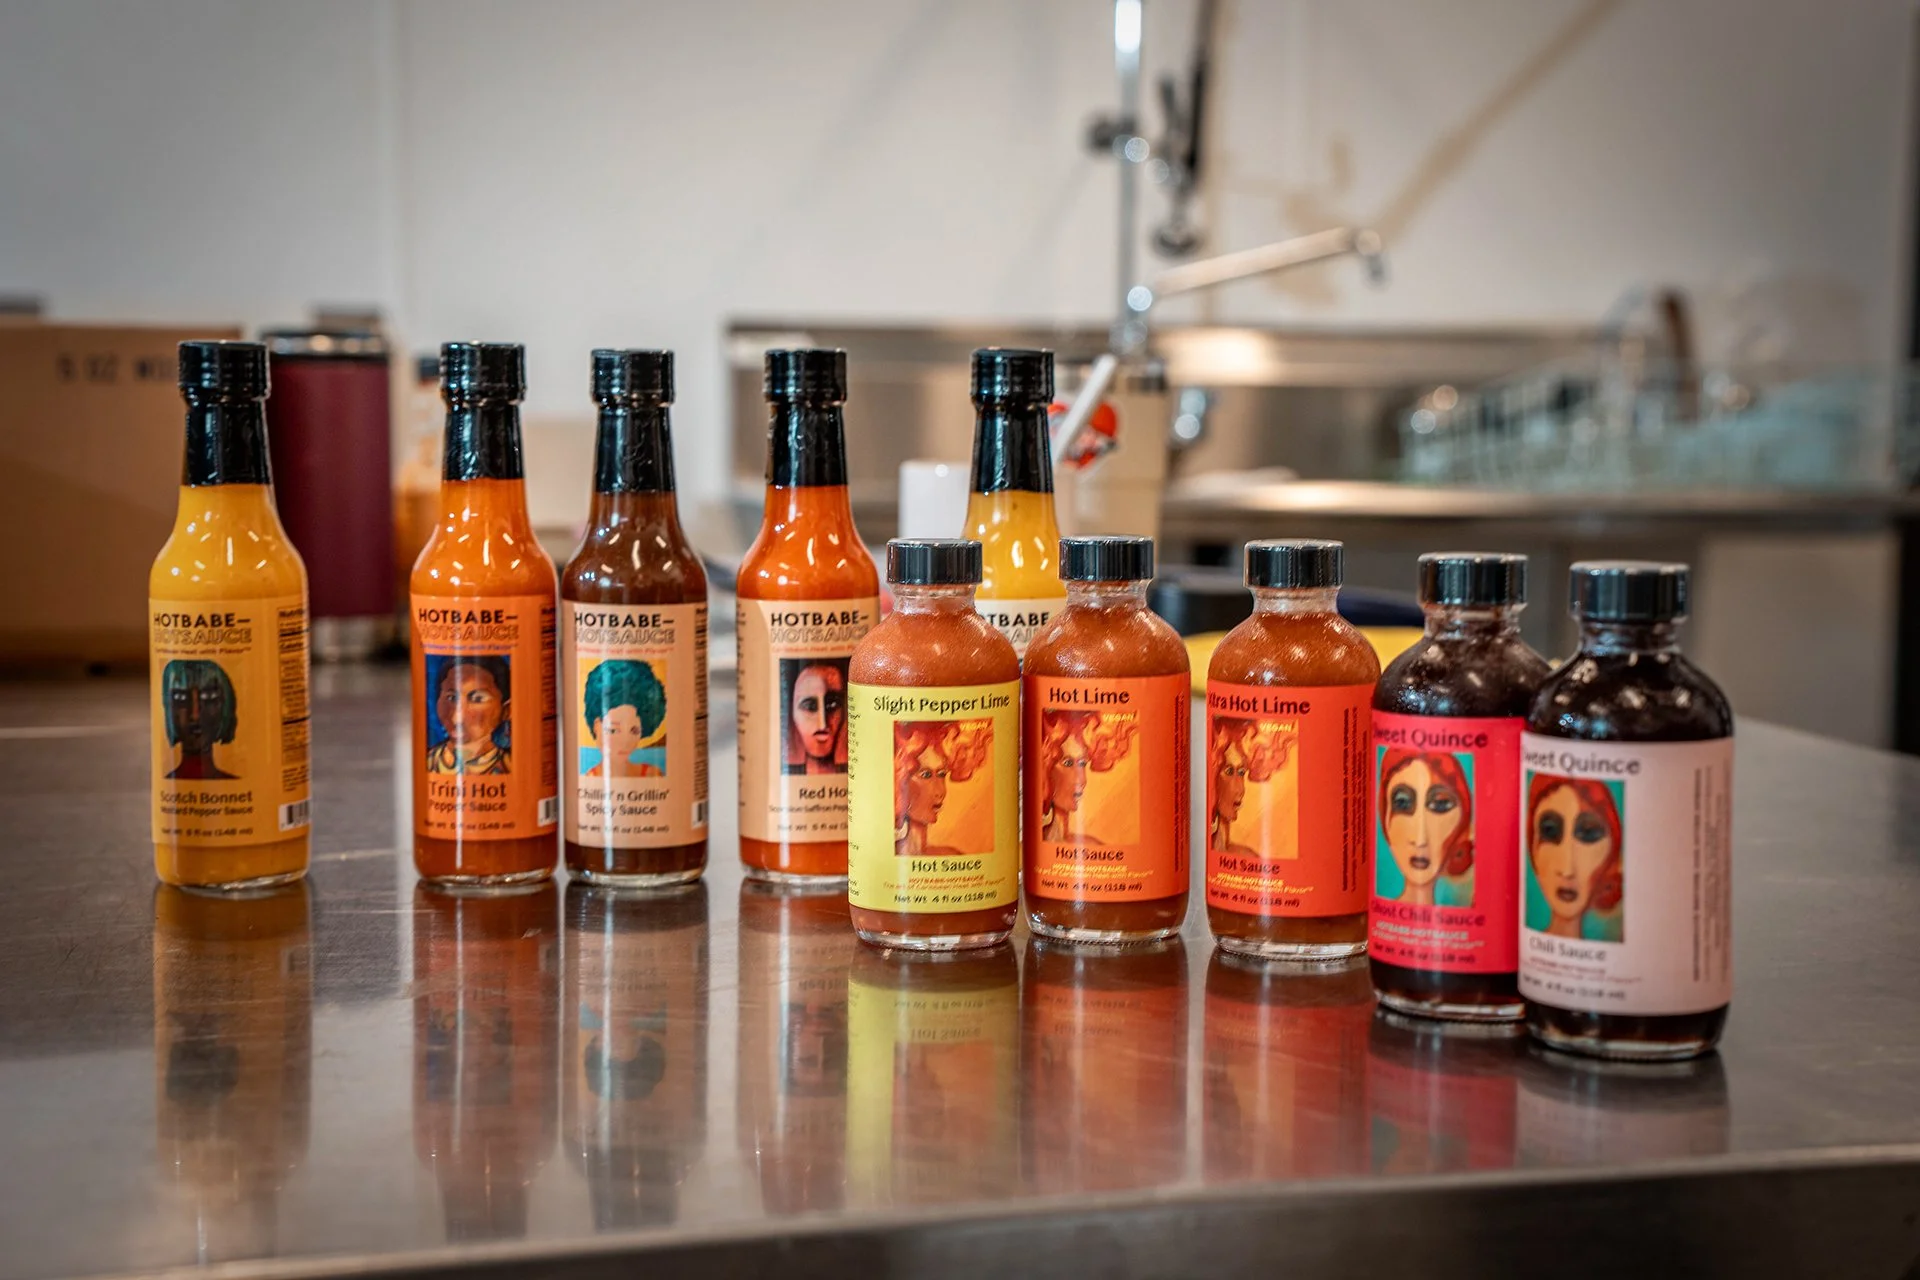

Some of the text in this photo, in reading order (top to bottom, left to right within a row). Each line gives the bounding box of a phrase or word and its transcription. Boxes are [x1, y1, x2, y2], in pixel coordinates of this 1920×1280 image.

[988, 612, 1049, 627] TBABE
[873, 692, 1010, 715] Slight Pepper Lime
[1049, 687, 1130, 704] Hot Lime
[1229, 695, 1258, 713] Hot
[1263, 697, 1311, 714] Lime
[1411, 729, 1488, 748] Quince
[1559, 752, 1641, 774] Quince
[160, 790, 252, 804] Scotch Bonnet
[430, 781, 507, 799] Trini Hot
[799, 786, 848, 800] Red Ho
[189, 807, 221, 817] Pepper
[224, 805, 253, 815] Sauce
[428, 801, 507, 813] Pepper Sauce
[619, 803, 657, 816] Sauce
[1055, 847, 1124, 861] Hot Sauce
[911, 858, 982, 873] Hot Sauce
[1219, 855, 1280, 875] Hot Sauce
[1437, 911, 1486, 927] Sauce
[1529, 935, 1607, 961] Chili Sauce
